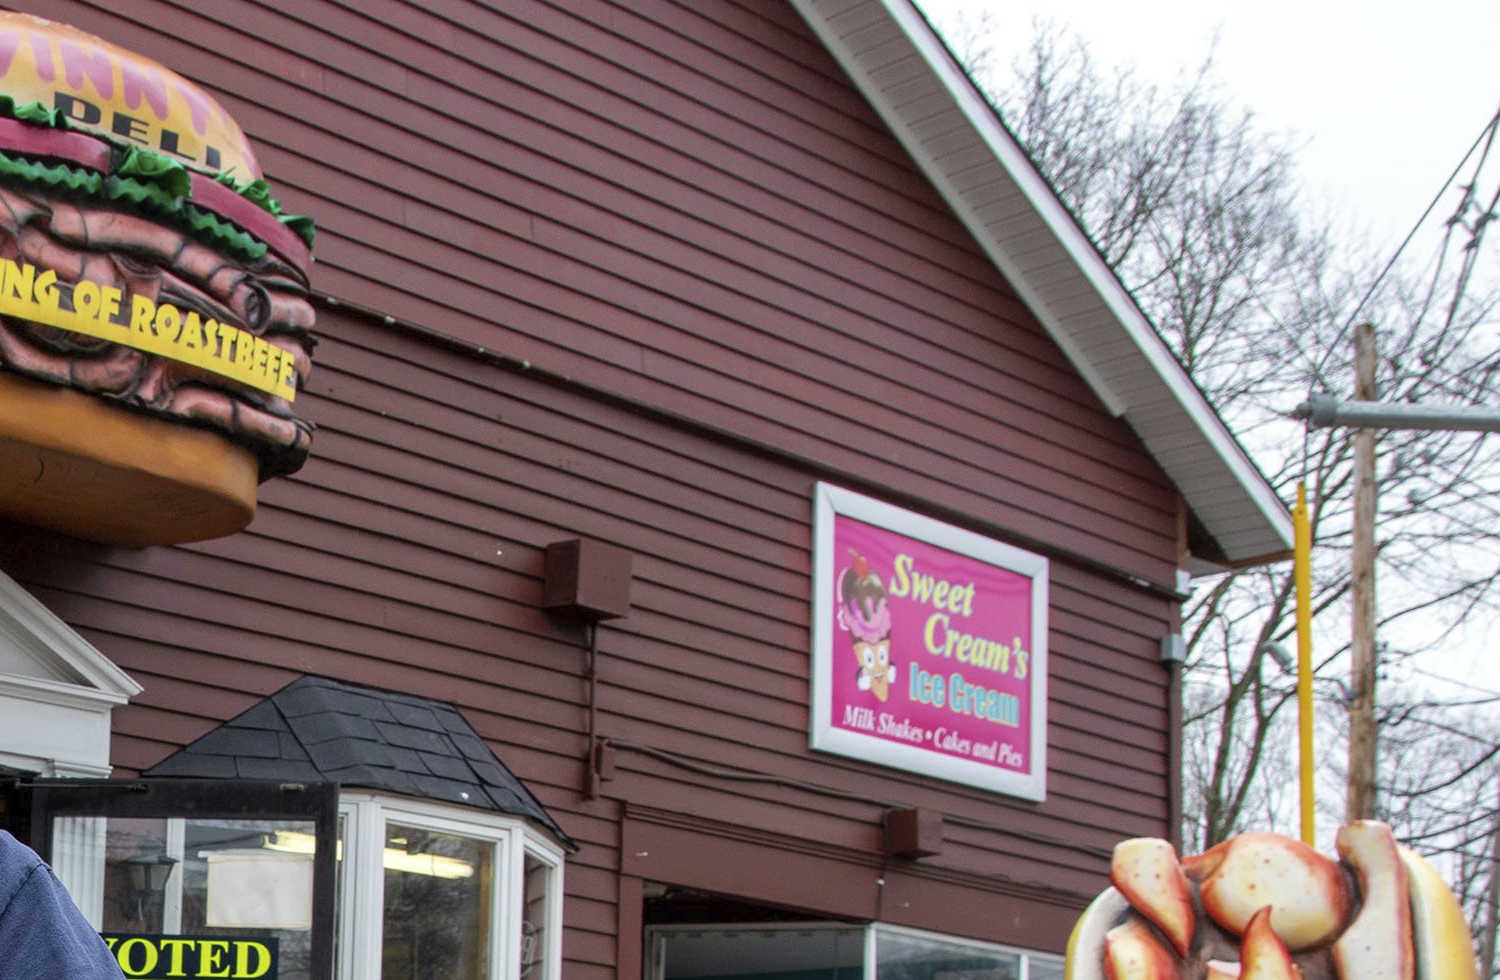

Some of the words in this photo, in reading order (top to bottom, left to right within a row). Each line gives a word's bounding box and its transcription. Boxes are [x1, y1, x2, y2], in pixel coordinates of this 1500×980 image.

[53, 91, 222, 169] DELI
[73, 283, 122, 325] OF
[131, 300, 296, 387] ROASTBEEF
[889, 553, 975, 617] Sweet
[923, 612, 1029, 680] Cream's
[909, 661, 946, 708] Ice
[949, 672, 1020, 728] Cream
[842, 704, 877, 731] Milk
[877, 712, 924, 743] Shakes
[933, 727, 971, 755] Cakes
[972, 741, 998, 760] and
[997, 743, 1024, 768] Pies
